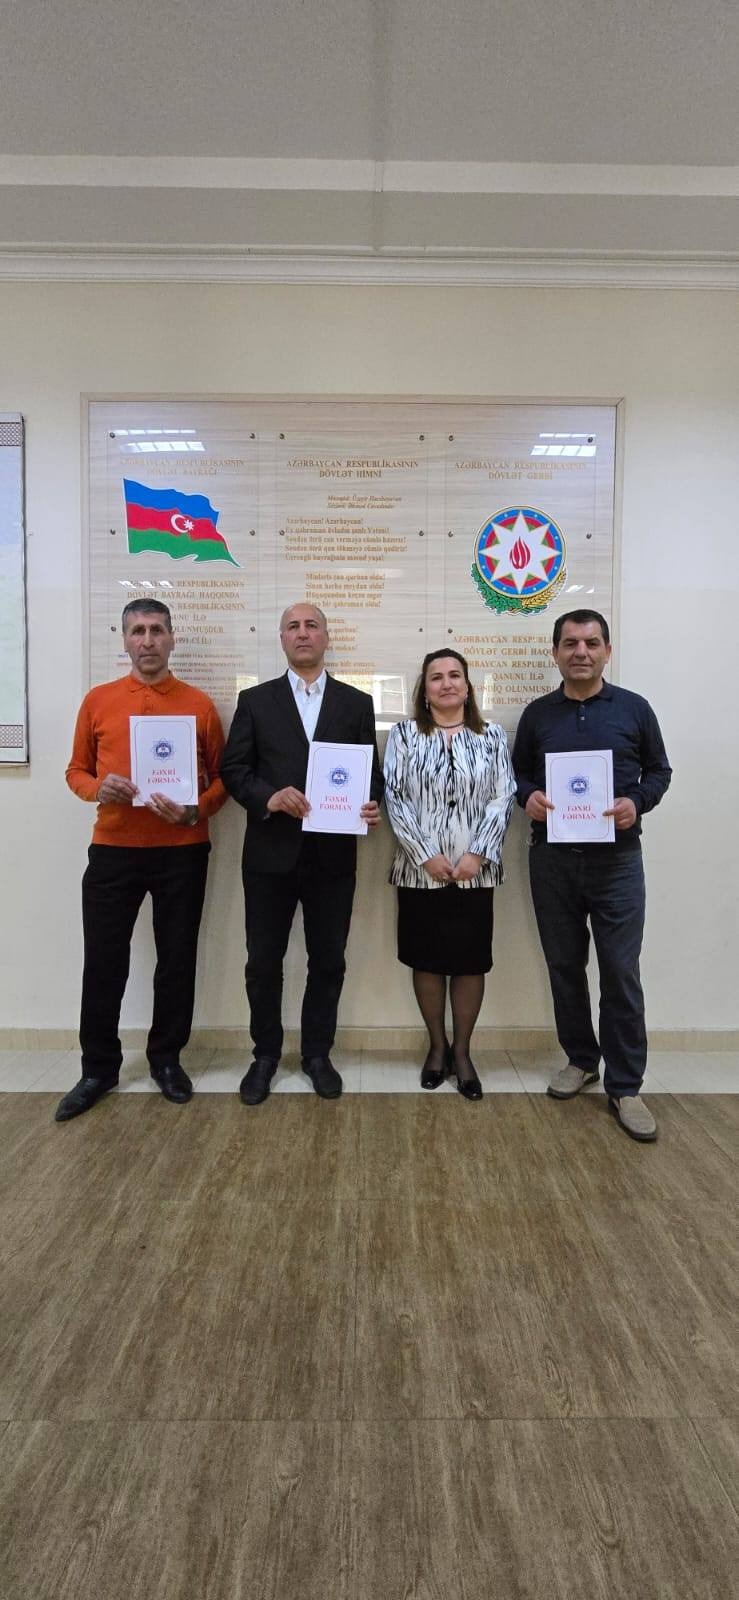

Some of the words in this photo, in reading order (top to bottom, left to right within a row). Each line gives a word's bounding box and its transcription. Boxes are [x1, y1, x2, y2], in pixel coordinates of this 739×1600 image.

[287, 459, 342, 468] AZƏRBAYCAN
[319, 469, 354, 478] DÖVLƏT
[488, 471, 523, 480] DÖVLƏT
[454, 635, 508, 644] AZƏRBAYCAN
[463, 646, 497, 656] DÖVLƏT
[501, 647, 528, 656] GERBİ
[491, 672, 525, 682] QANUNU
[529, 671, 545, 681] İLƏ
[152, 768, 176, 776] FƏXRİ
[325, 795, 348, 803] FƏXRİ
[319, 803, 352, 811] FƏRMAN
[567, 804, 592, 812] FƏXRİ
[562, 813, 597, 821] FƏRMAN
